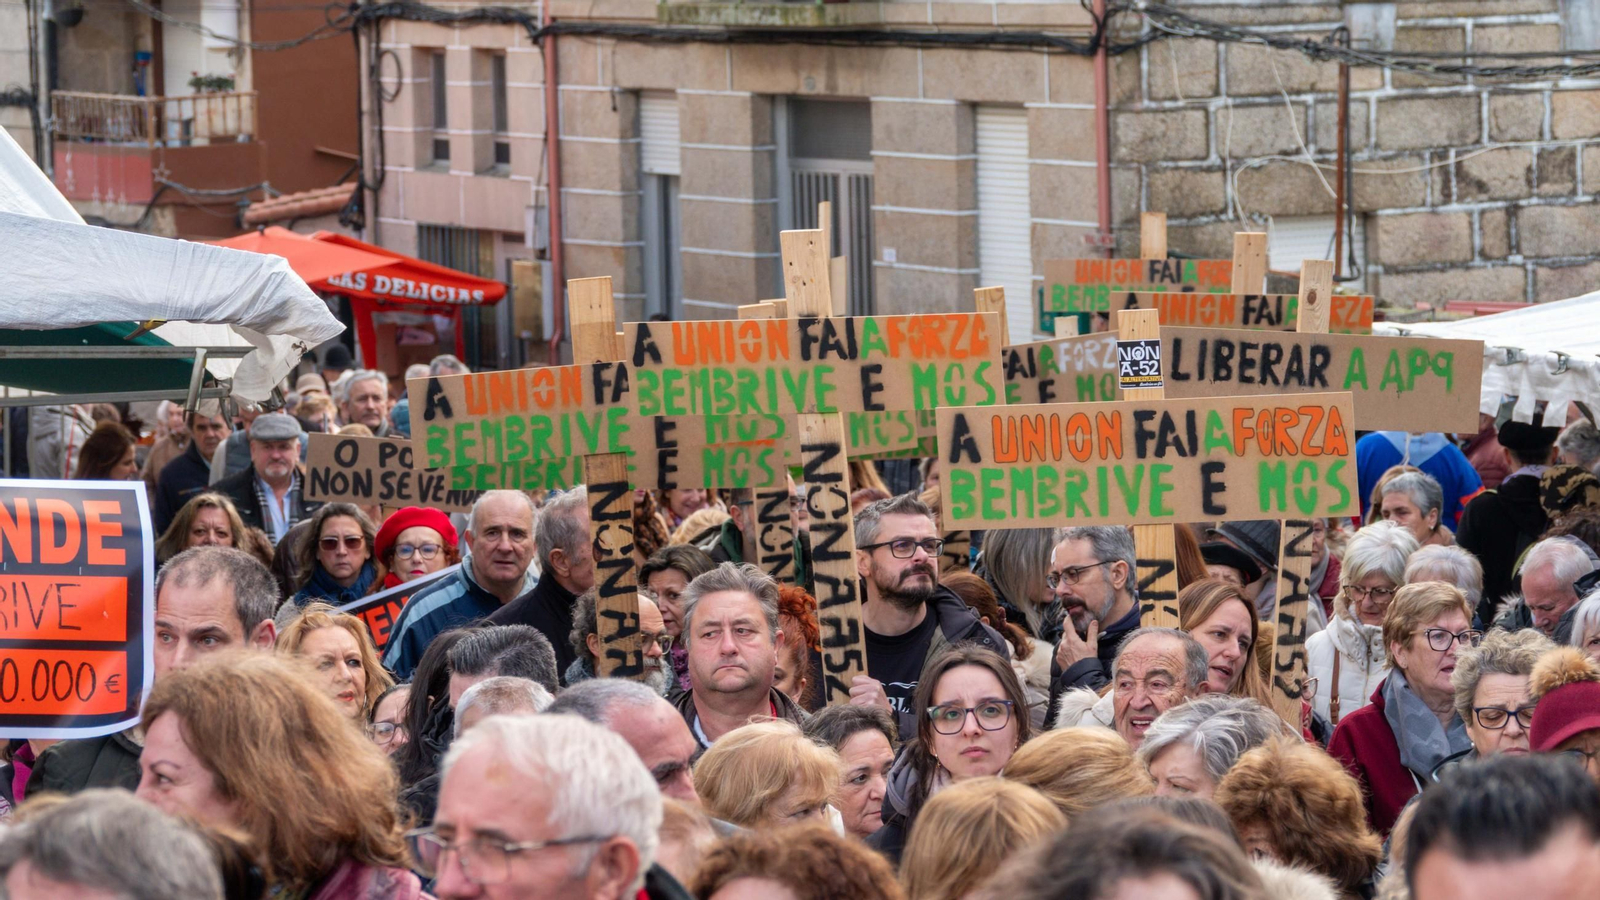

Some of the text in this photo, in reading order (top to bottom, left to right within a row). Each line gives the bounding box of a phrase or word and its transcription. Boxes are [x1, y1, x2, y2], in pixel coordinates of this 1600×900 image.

[373, 275, 485, 303] DELICIAS
[1075, 259, 1144, 284] UNION
[1150, 259, 1182, 284] FAI
[1200, 260, 1233, 284] FOR
[1153, 293, 1235, 325] UNION
[1242, 294, 1283, 326] FAI
[1330, 297, 1373, 328] RZA
[633, 313, 989, 366] A UNION FAI A FORZA
[1037, 344, 1060, 377] A
[1058, 337, 1116, 373] FORZ
[1121, 360, 1159, 376] A-52
[1172, 338, 1330, 389] LIBERAR
[1343, 347, 1369, 391] A
[423, 361, 630, 421] A UNION FA
[637, 364, 838, 416] BEMBRIVE
[860, 364, 885, 411] E
[911, 361, 997, 411] MOS
[1076, 373, 1117, 402] MO
[334, 439, 359, 468] O
[426, 407, 637, 469] BEMBRIVE
[950, 413, 981, 463] A
[991, 410, 1122, 464] UNION
[1133, 409, 1199, 458] FAI
[1204, 409, 1234, 457] A
[1233, 406, 1350, 457] FORZA
[310, 466, 373, 498] NON
[379, 471, 412, 500] SE
[452, 447, 776, 490] BEMBRI E MOS
[951, 459, 1351, 520] BEMBRIVE E MOS
